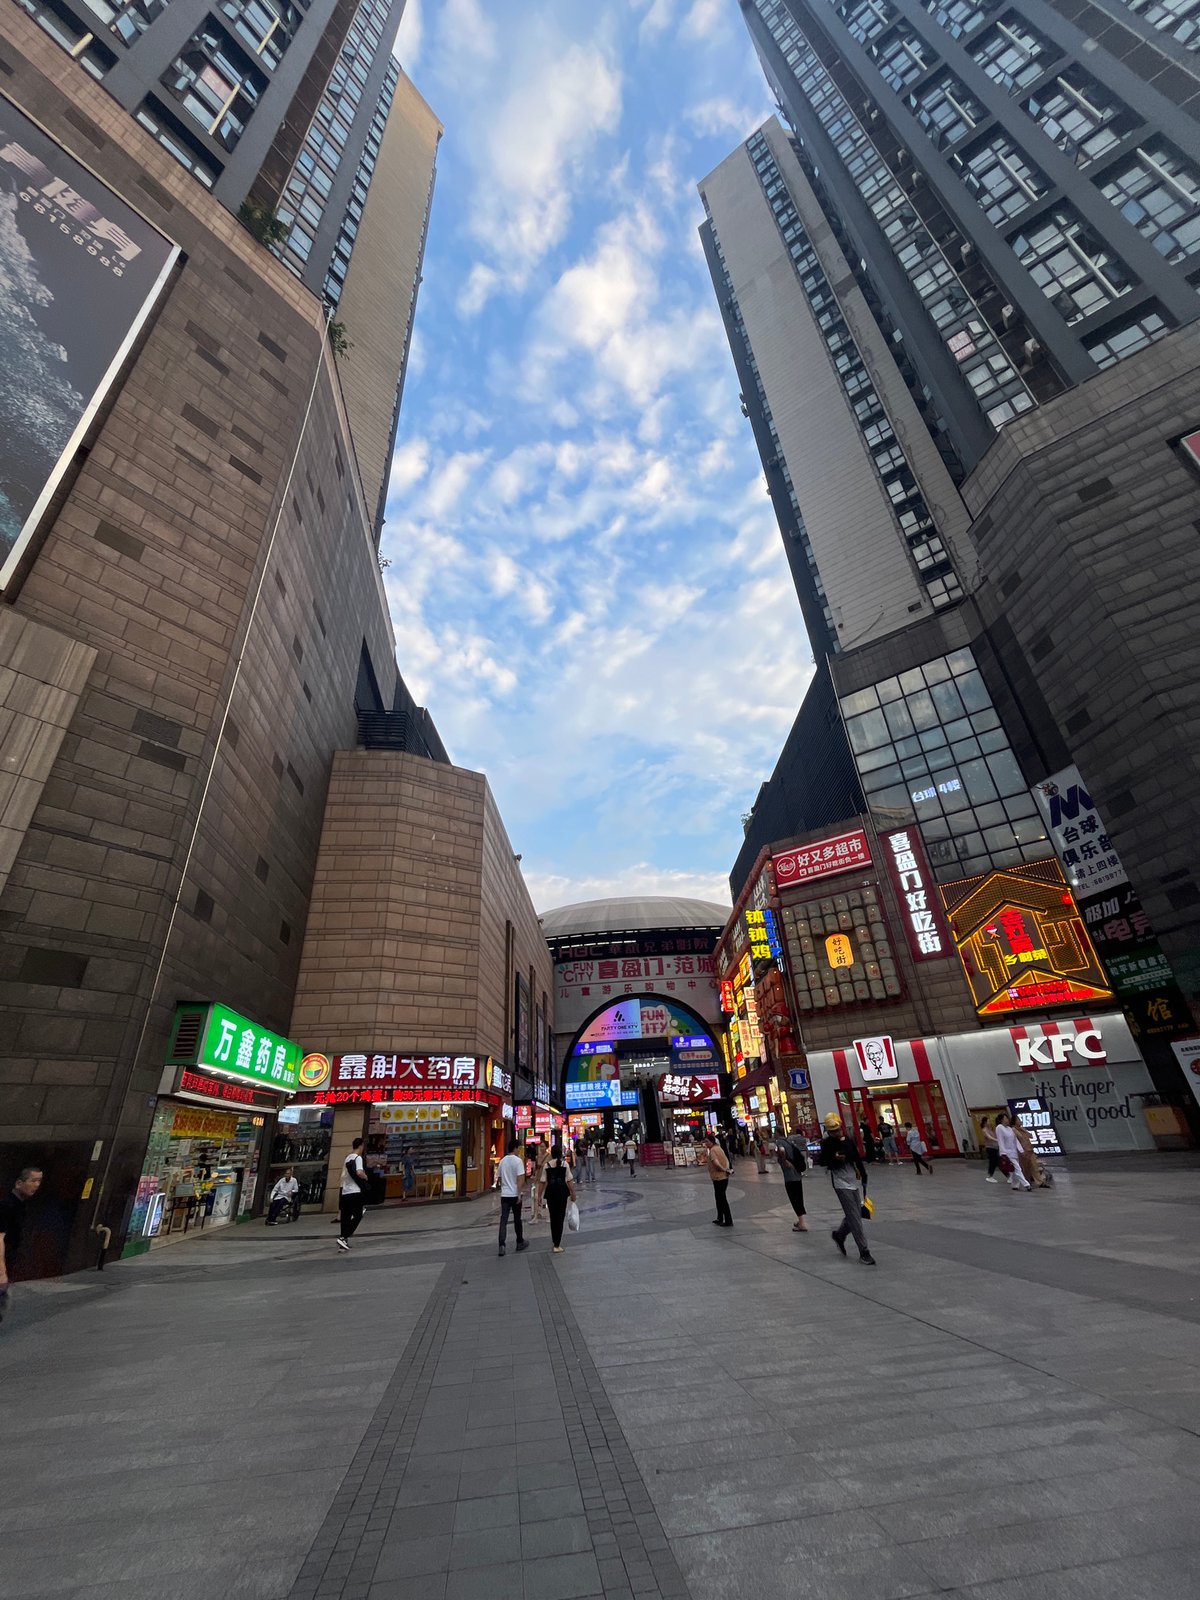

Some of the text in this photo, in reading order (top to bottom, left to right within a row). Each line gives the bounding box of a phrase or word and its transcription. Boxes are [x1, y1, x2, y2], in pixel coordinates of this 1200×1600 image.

[19, 190, 124, 277] 68158988
[912, 787, 938, 802] 台球
[1062, 814, 1099, 844] 台球
[797, 838, 862, 868] 好又多超市
[1062, 834, 1113, 868] 俱乐部
[1075, 854, 1120, 880] 请上四楼
[888, 831, 942, 955] 喜盈门好吃街
[1085, 896, 1121, 924] 极加
[746, 910, 772, 959] 钵钵鸡
[832, 937, 847, 965] 好吃街
[1004, 949, 1048, 966] 乡村菜
[563, 971, 594, 983] CITY
[573, 962, 594, 972] FUN
[598, 955, 716, 980] 喜盈门·范城
[560, 980, 718, 999] 儿童游乐购物中心
[640, 1009, 665, 1021] FUN
[214, 1018, 287, 1080] 万鑫药房
[1016, 1030, 1107, 1067] KFC
[338, 1054, 476, 1080] 鑫斛大药房
[662, 1084, 690, 1097] 好吃街
[1059, 1074, 1116, 1103] finger
[1086, 1095, 1135, 1128] good
